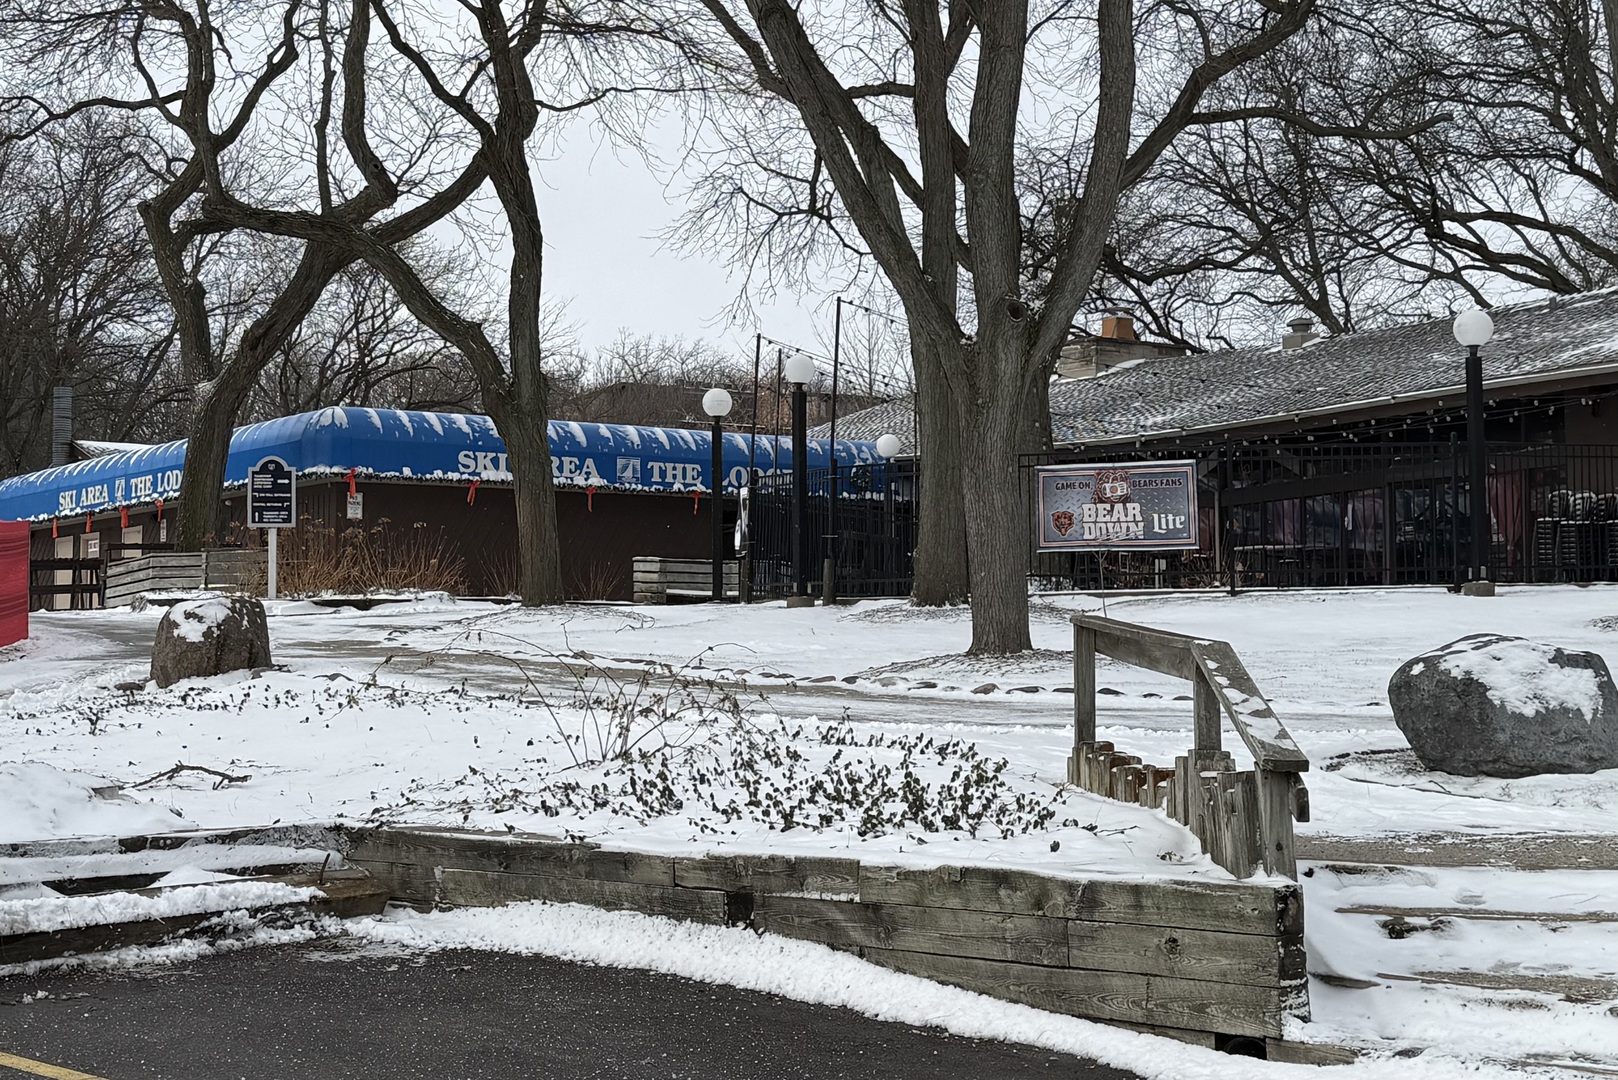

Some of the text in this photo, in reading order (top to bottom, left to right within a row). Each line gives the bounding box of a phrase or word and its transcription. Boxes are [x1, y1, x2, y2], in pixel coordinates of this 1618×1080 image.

[458, 451, 600, 479] SKI REA
[647, 461, 702, 485] THE
[130, 469, 184, 497] THE LOD
[1055, 477, 1183, 491] GAME ON, BEARS FANS
[59, 483, 109, 511] SKI AREA
[1082, 502, 1143, 523] BEAR
[1152, 513, 1186, 534] Lite
[1082, 522, 1145, 540] DOWN
